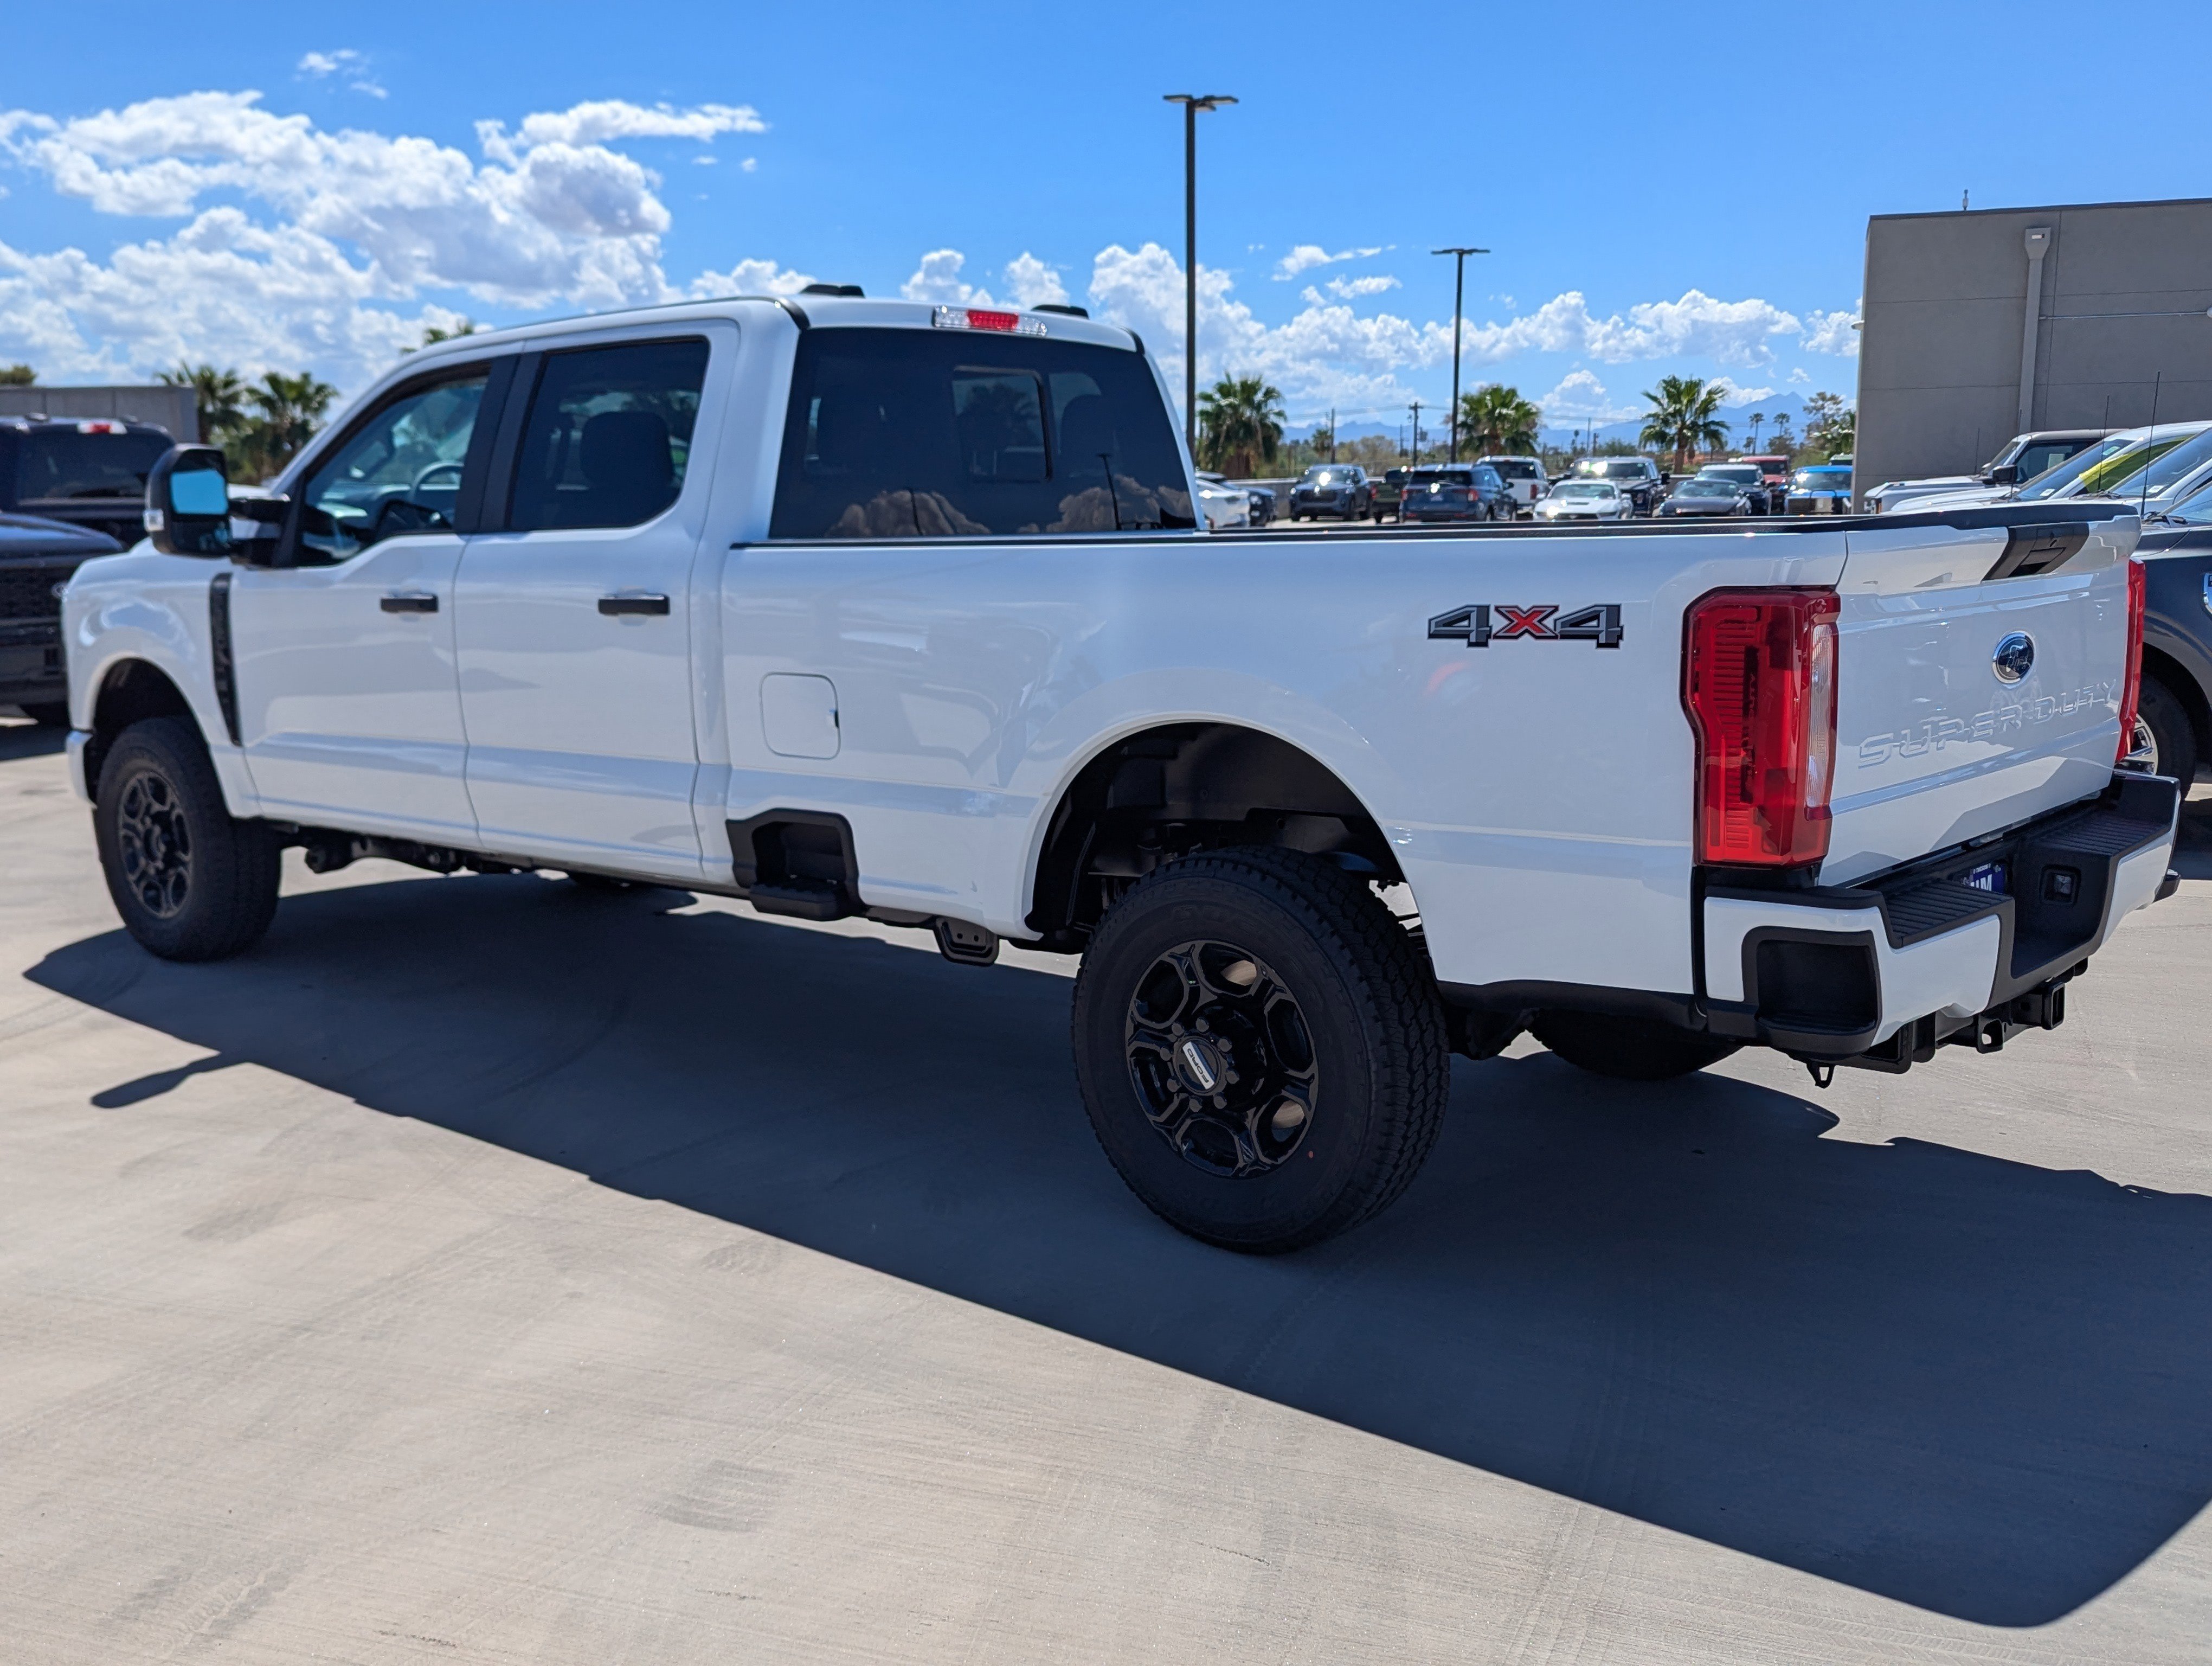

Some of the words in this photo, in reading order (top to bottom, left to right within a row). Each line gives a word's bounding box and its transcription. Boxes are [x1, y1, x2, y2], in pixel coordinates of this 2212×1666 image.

[1426, 603, 1625, 650] 4X4
[1858, 704, 2023, 769] SUPER
[2033, 678, 2117, 725] DUTY
[1186, 1047, 1210, 1084] FORD
